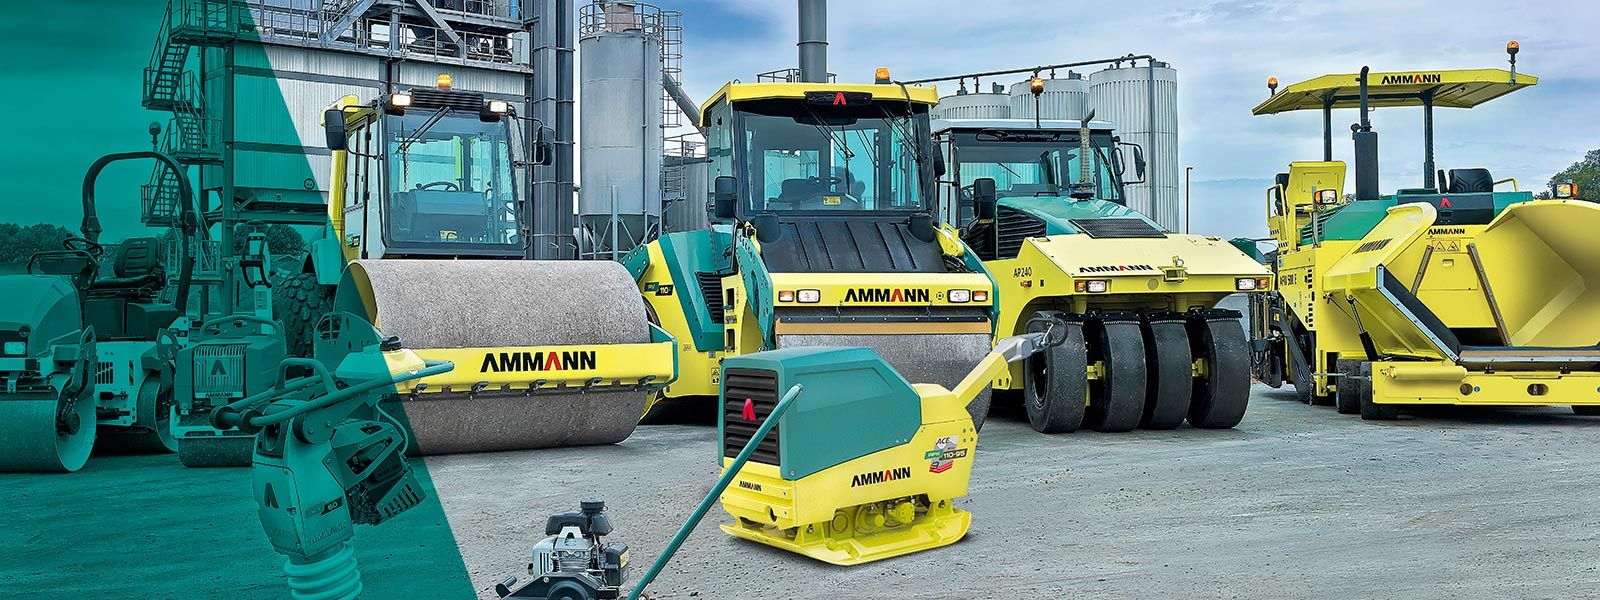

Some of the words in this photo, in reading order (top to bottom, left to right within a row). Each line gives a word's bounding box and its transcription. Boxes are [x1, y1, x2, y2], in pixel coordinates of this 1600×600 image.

[1381, 74, 1440, 84] AMMANN
[1079, 264, 1153, 273] AMMANN
[844, 288, 929, 302] AMMANN
[480, 351, 596, 373] AMMANN
[936, 437, 950, 445] ACE
[943, 451, 966, 459] 110-95
[851, 466, 910, 488] AMMANN
